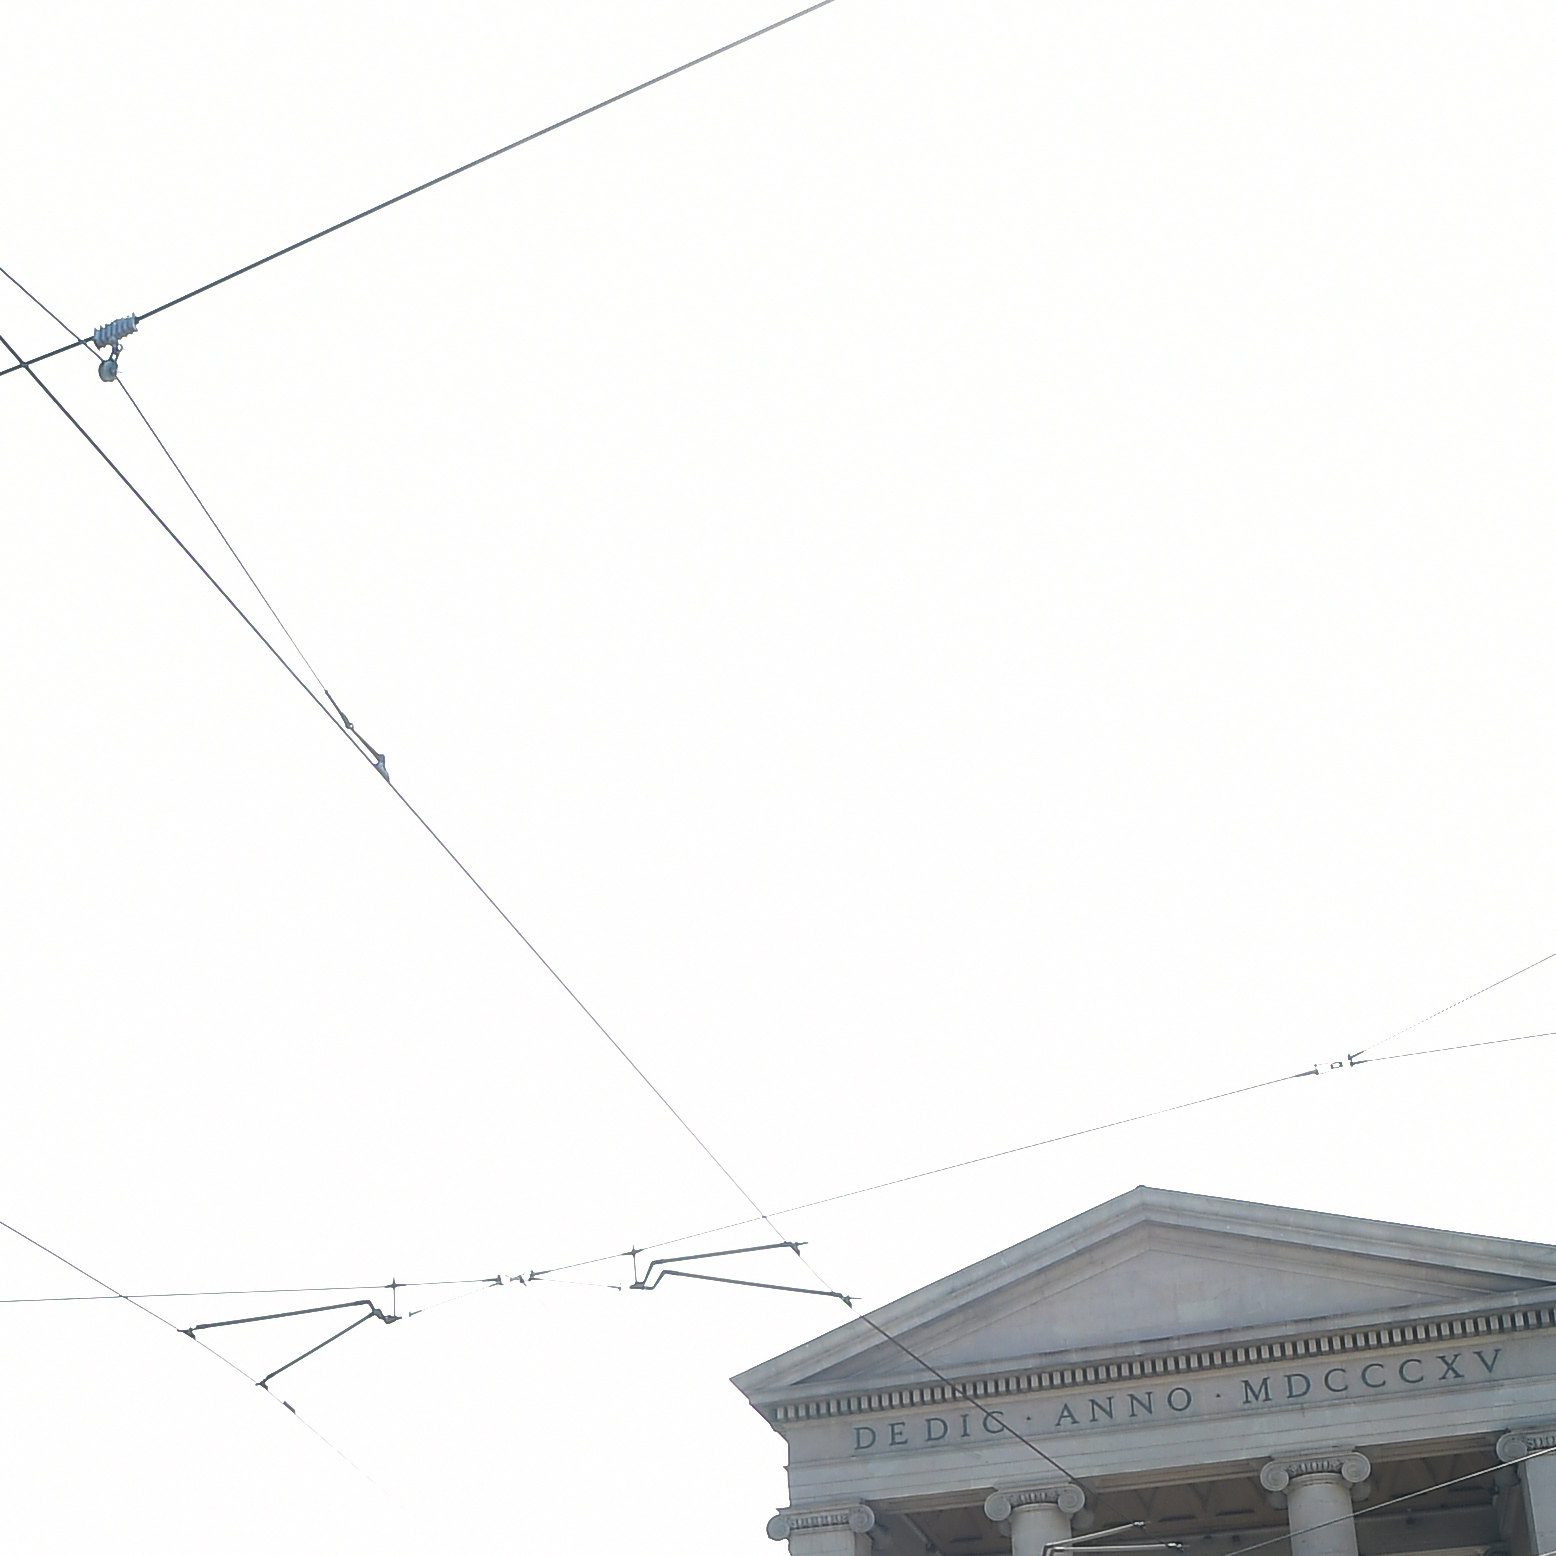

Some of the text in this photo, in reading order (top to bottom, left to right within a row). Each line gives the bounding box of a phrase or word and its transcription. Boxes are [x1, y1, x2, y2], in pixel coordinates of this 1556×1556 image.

[854, 1348, 1503, 1450] DEDIC ANNO MDCCCXV
